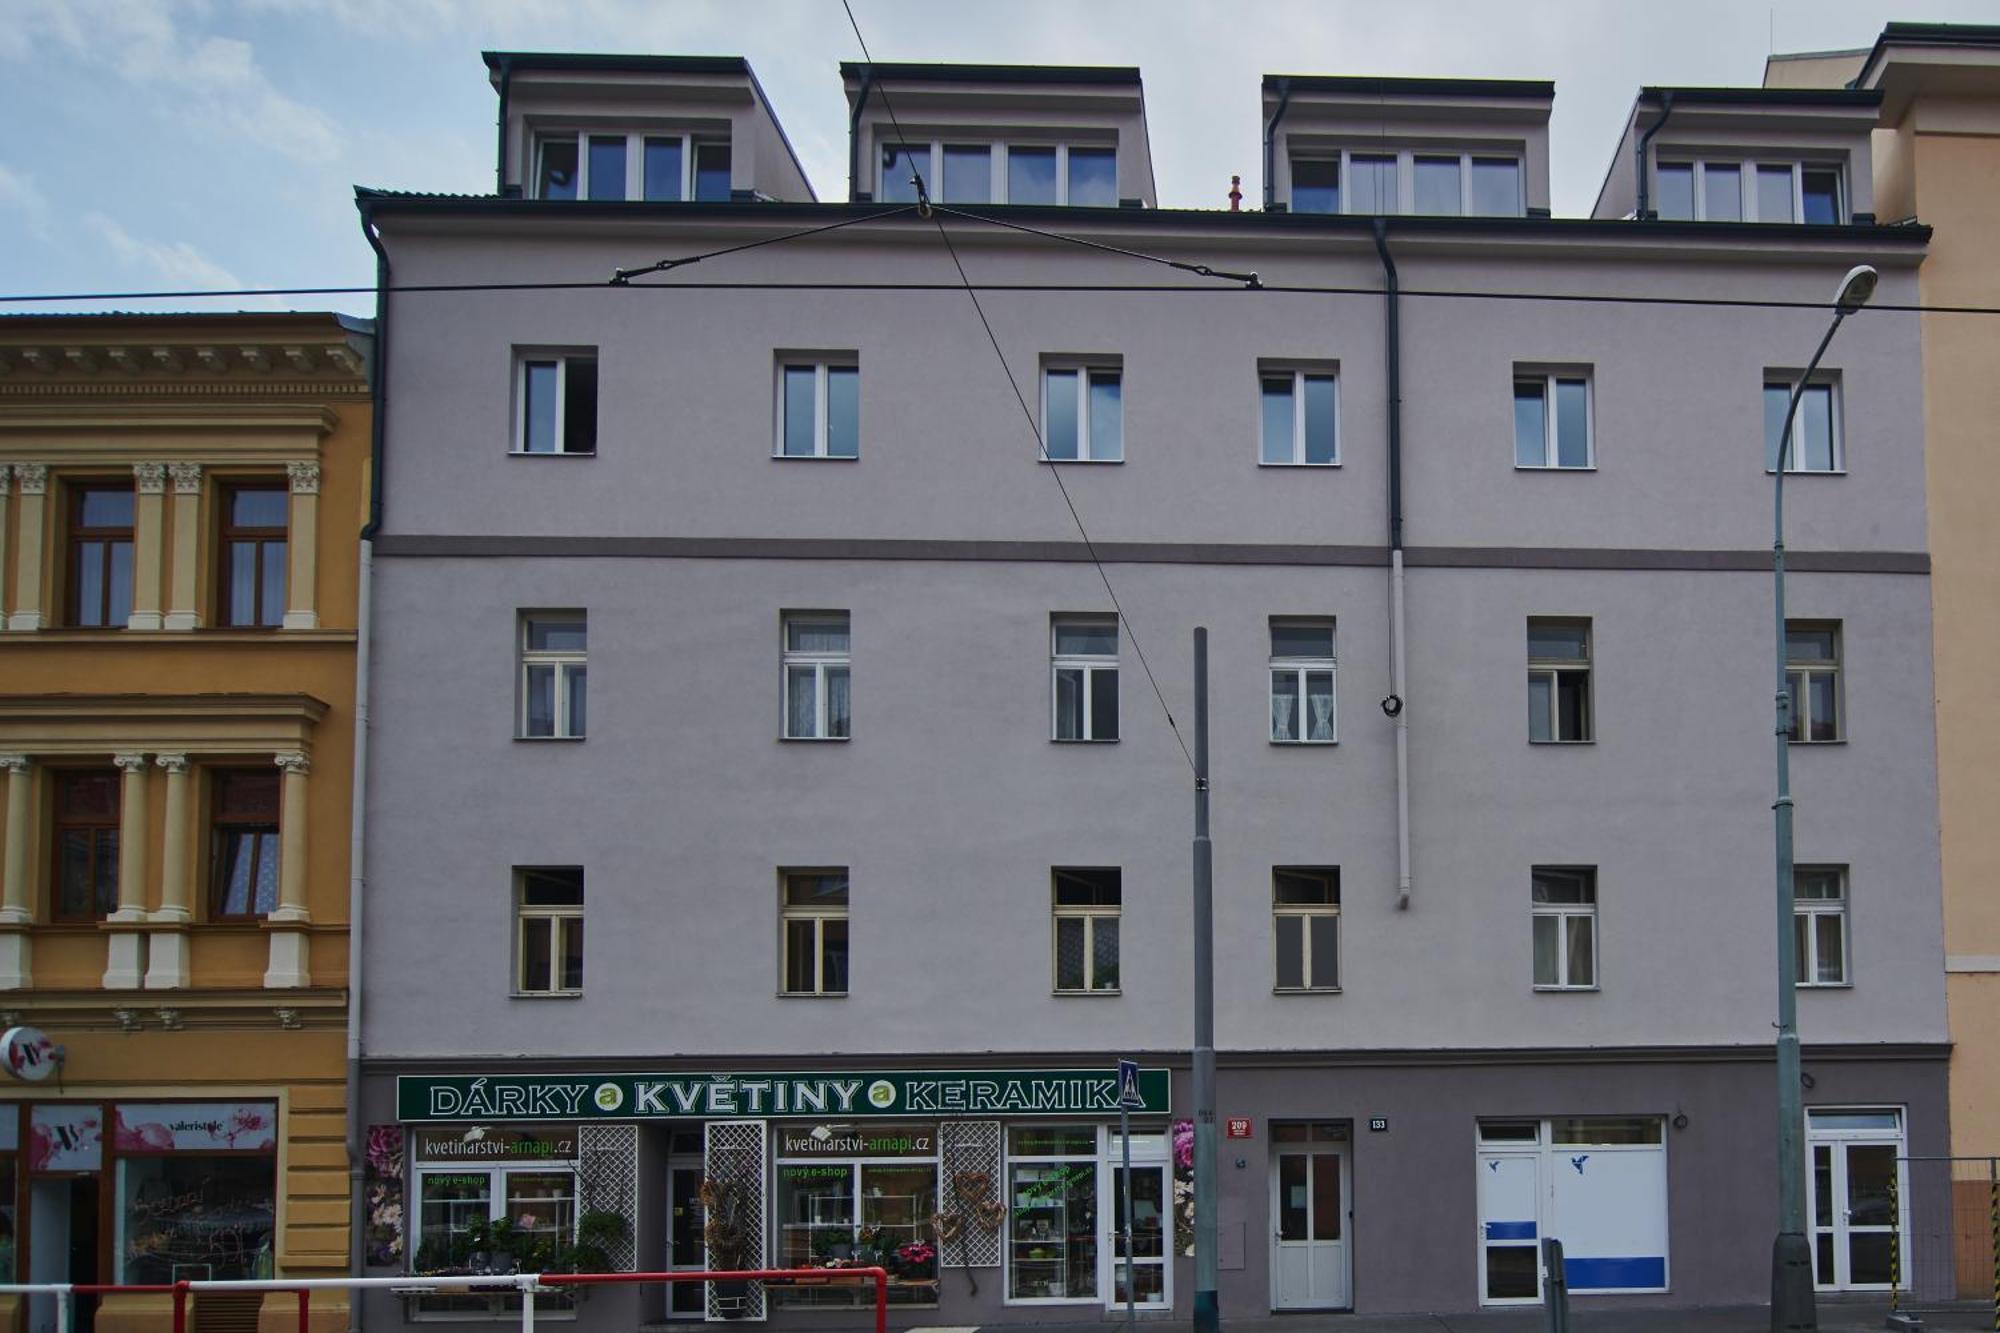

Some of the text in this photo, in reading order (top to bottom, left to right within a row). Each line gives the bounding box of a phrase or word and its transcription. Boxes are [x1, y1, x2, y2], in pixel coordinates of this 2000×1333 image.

[430, 1077, 589, 1115] DÁRKY
[634, 1074, 864, 1114] KVĚTINY
[1372, 1120, 1385, 1129] 133
